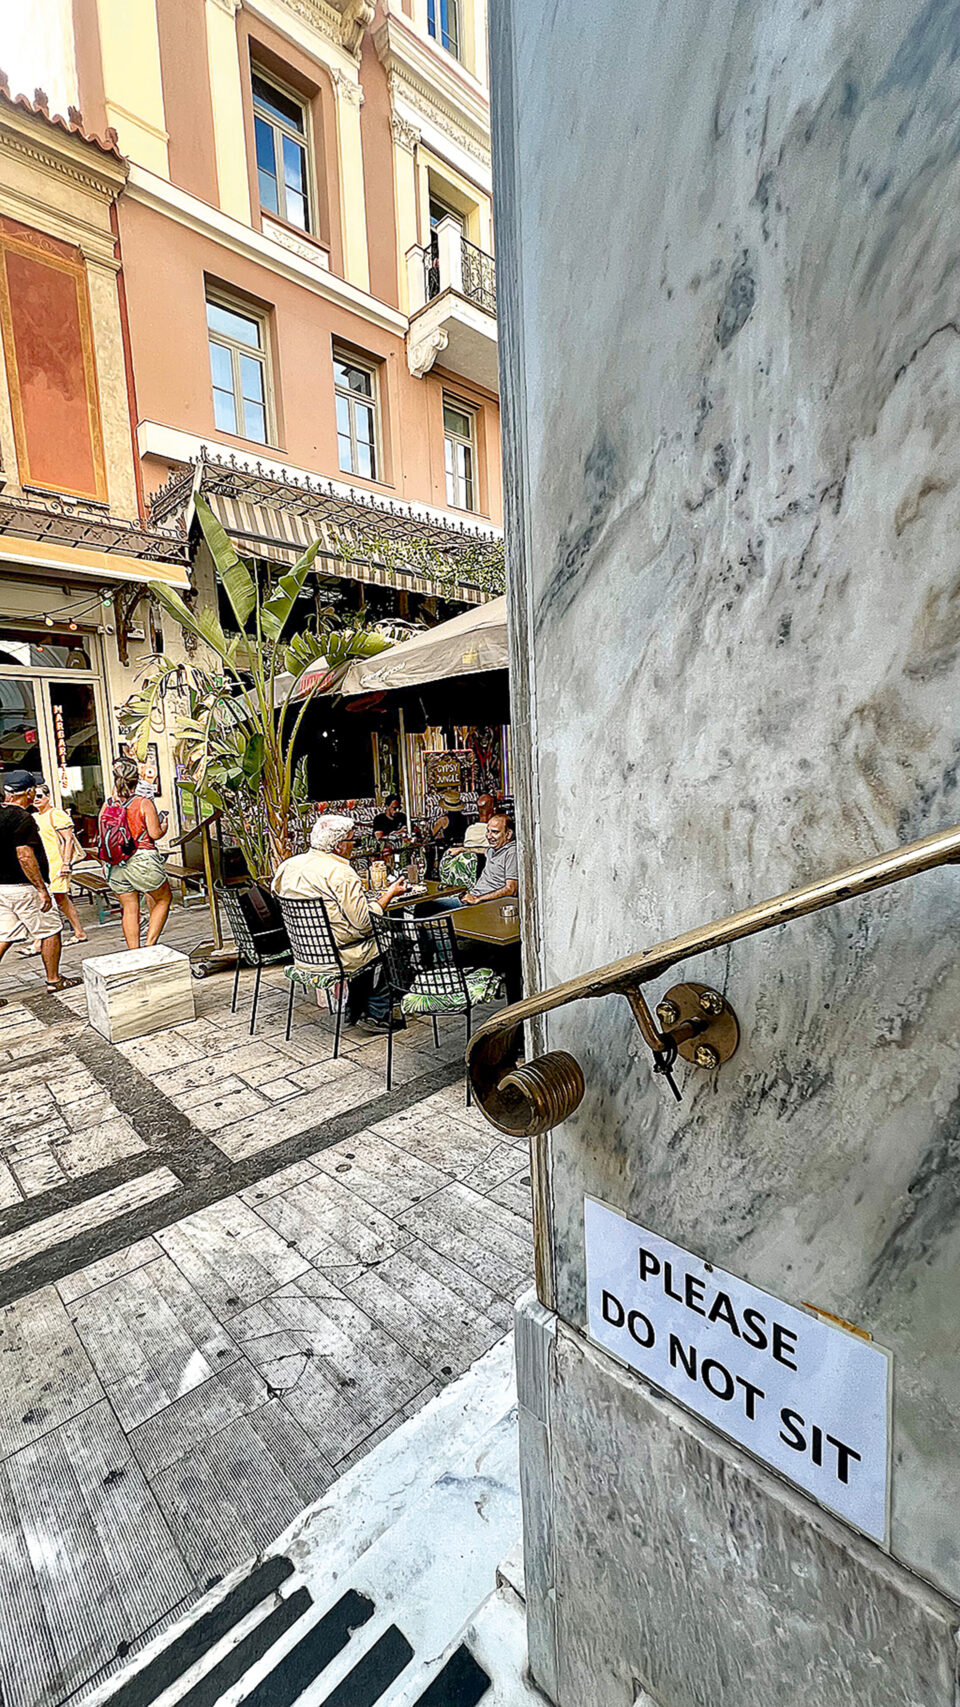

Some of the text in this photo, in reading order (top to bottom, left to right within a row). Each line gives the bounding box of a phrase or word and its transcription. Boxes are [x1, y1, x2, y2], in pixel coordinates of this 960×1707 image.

[53, 705, 68, 789] MARGARITAS
[639, 1248, 798, 1372] PLEASE
[602, 1290, 861, 1485] DO NOT SIT
